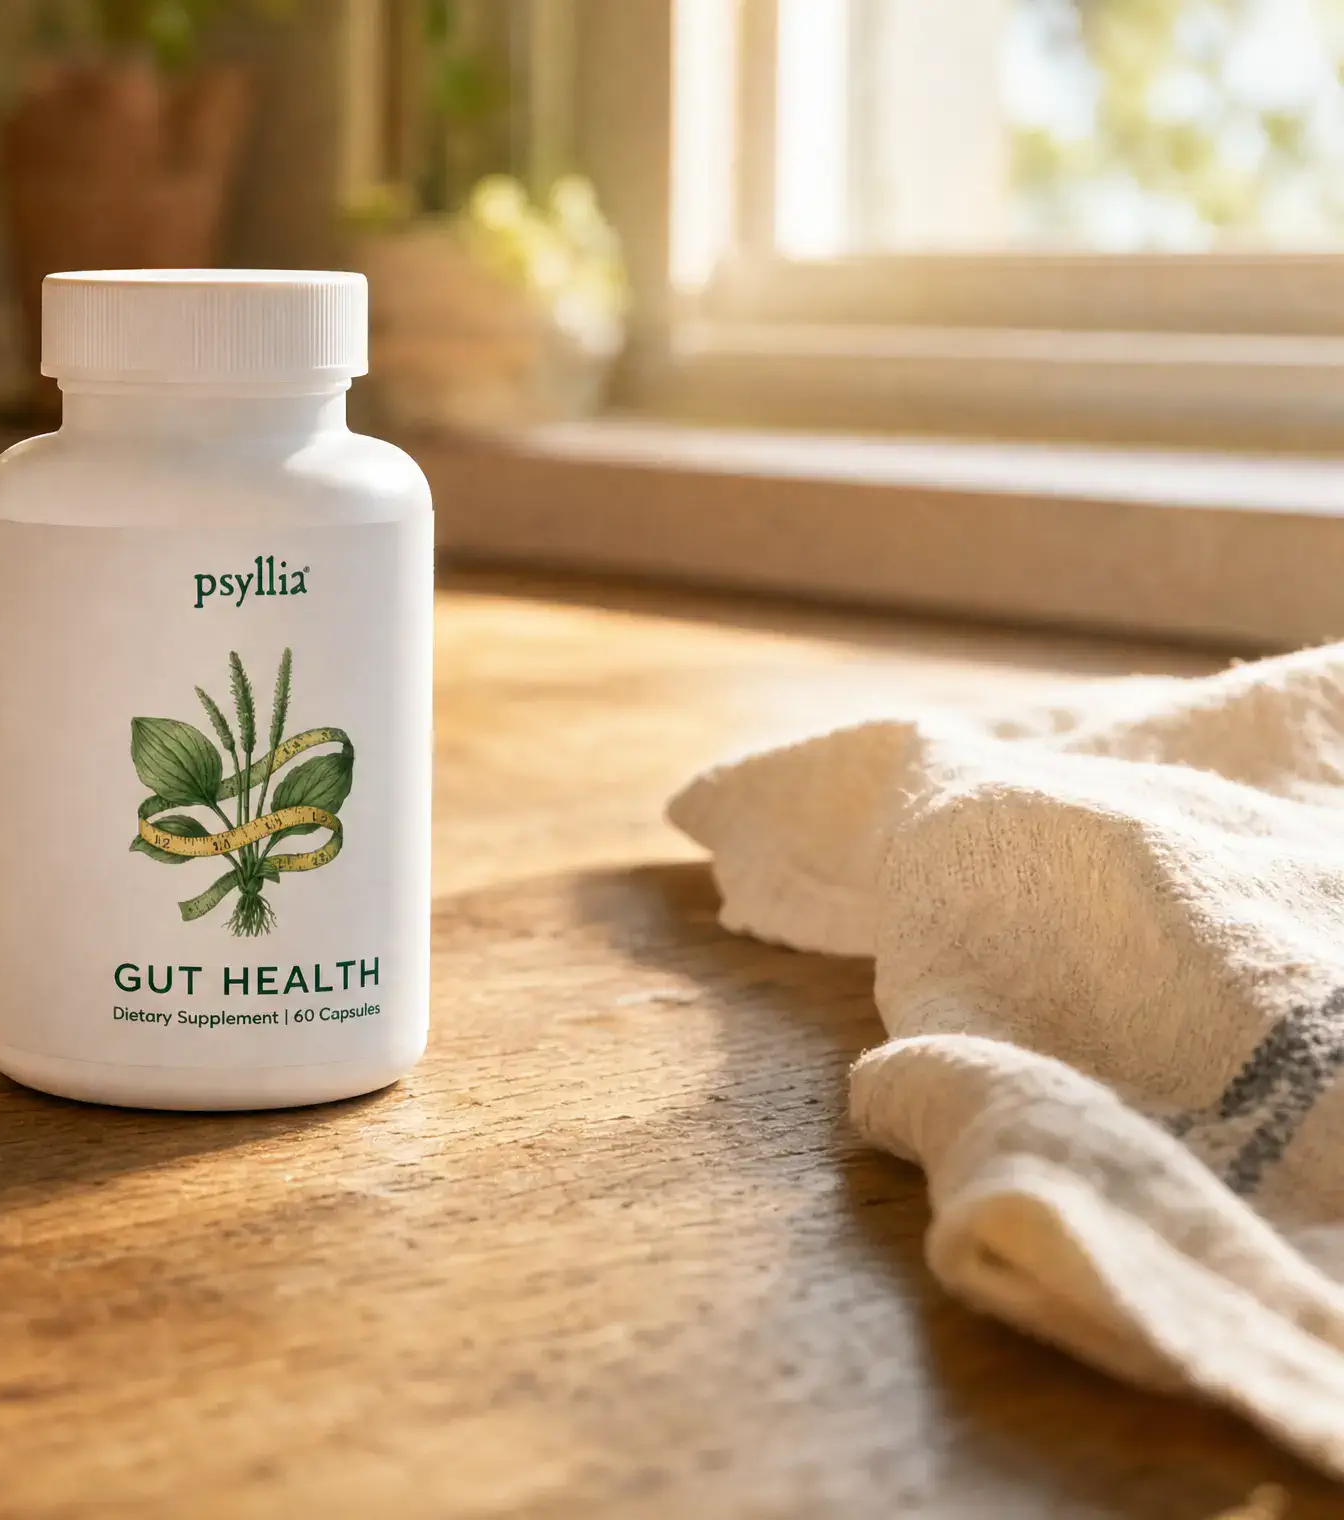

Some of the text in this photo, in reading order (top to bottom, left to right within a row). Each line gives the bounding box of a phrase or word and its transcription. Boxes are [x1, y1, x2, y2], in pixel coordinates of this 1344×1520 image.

[113, 956, 380, 996] GUT HEALTH
[113, 1006, 173, 1027] Dietary
[177, 1010, 280, 1029] Supplement
[293, 1008, 315, 1024] 60
[319, 1002, 381, 1024] Capsules
